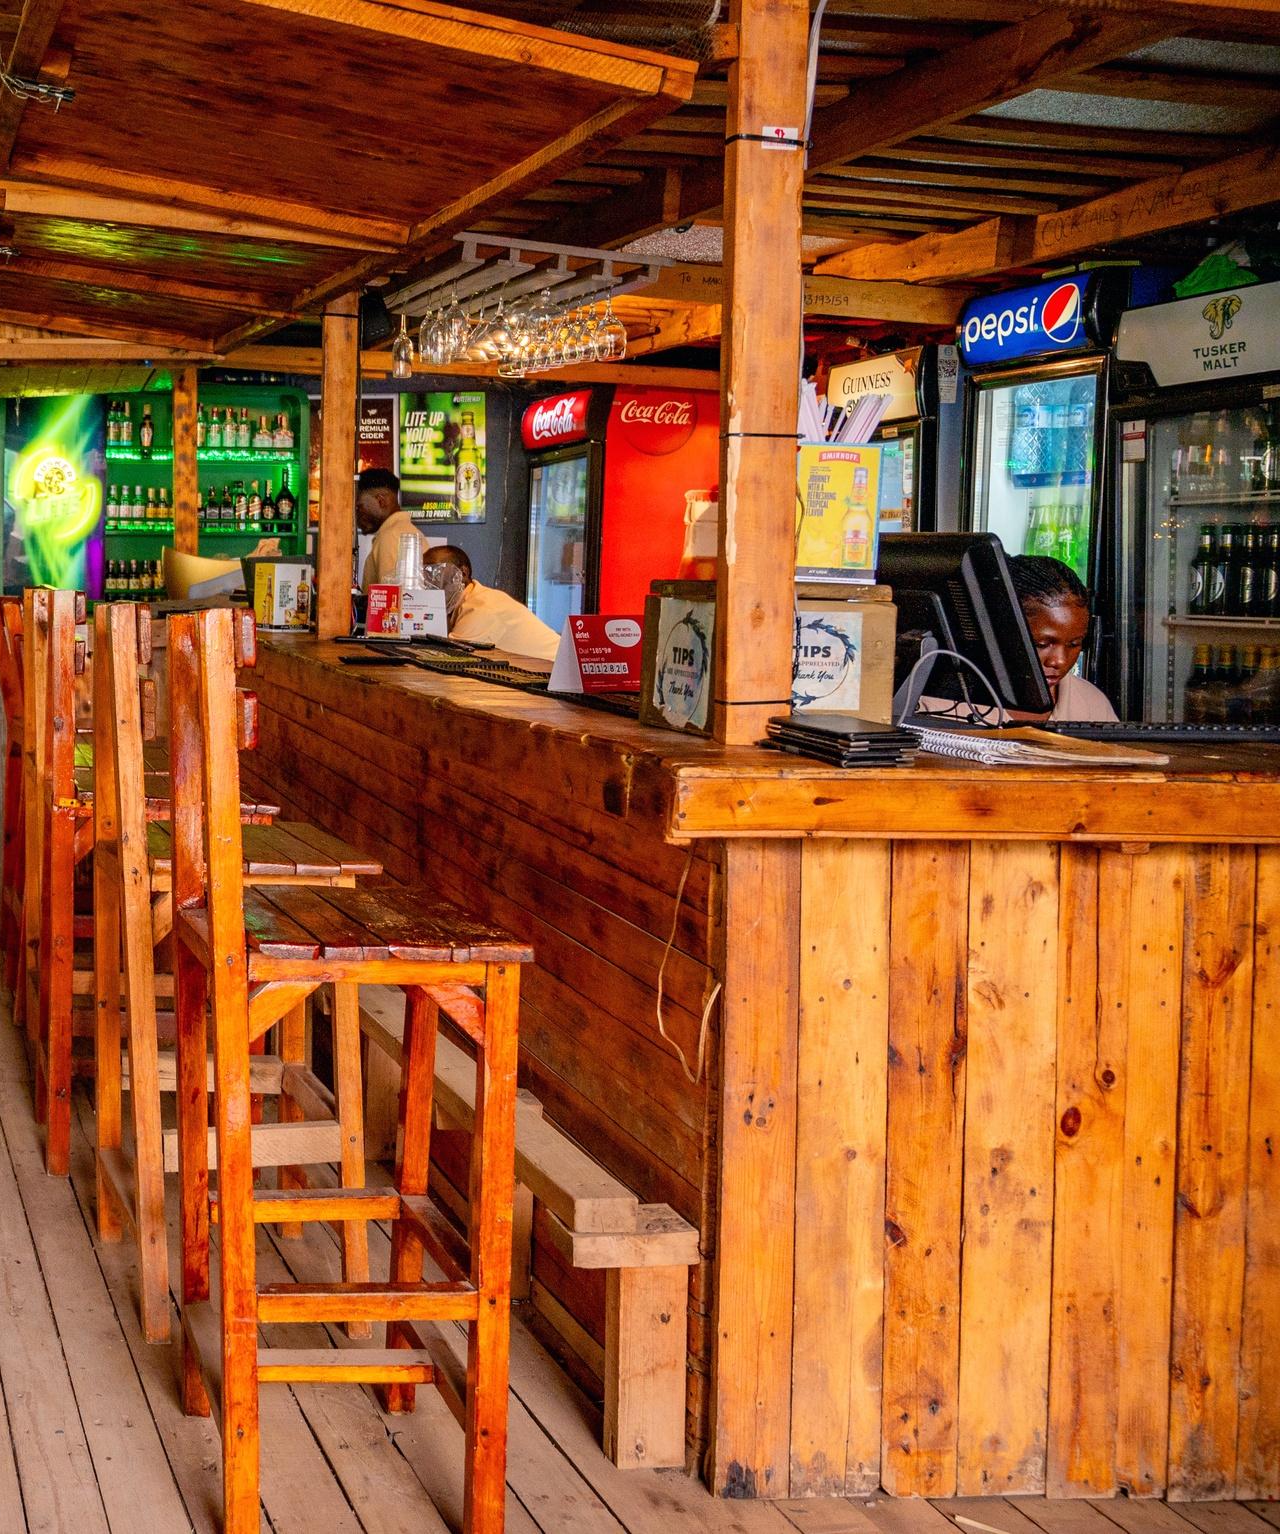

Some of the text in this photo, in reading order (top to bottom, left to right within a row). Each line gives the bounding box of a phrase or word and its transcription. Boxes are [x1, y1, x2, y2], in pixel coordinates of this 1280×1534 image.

[964, 297, 1038, 352] pepsi
[1193, 341, 1247, 357] TUSKER
[1203, 356, 1239, 371] MALT
[842, 370, 892, 395] GUINNESS
[404, 411, 445, 427] LITE UP
[620, 399, 693, 425] Coca-Cola
[405, 427, 433, 443] YOUR
[672, 646, 695, 667] TIPS
[583, 664, 627, 673] 1212826
[817, 670, 835, 682] You
